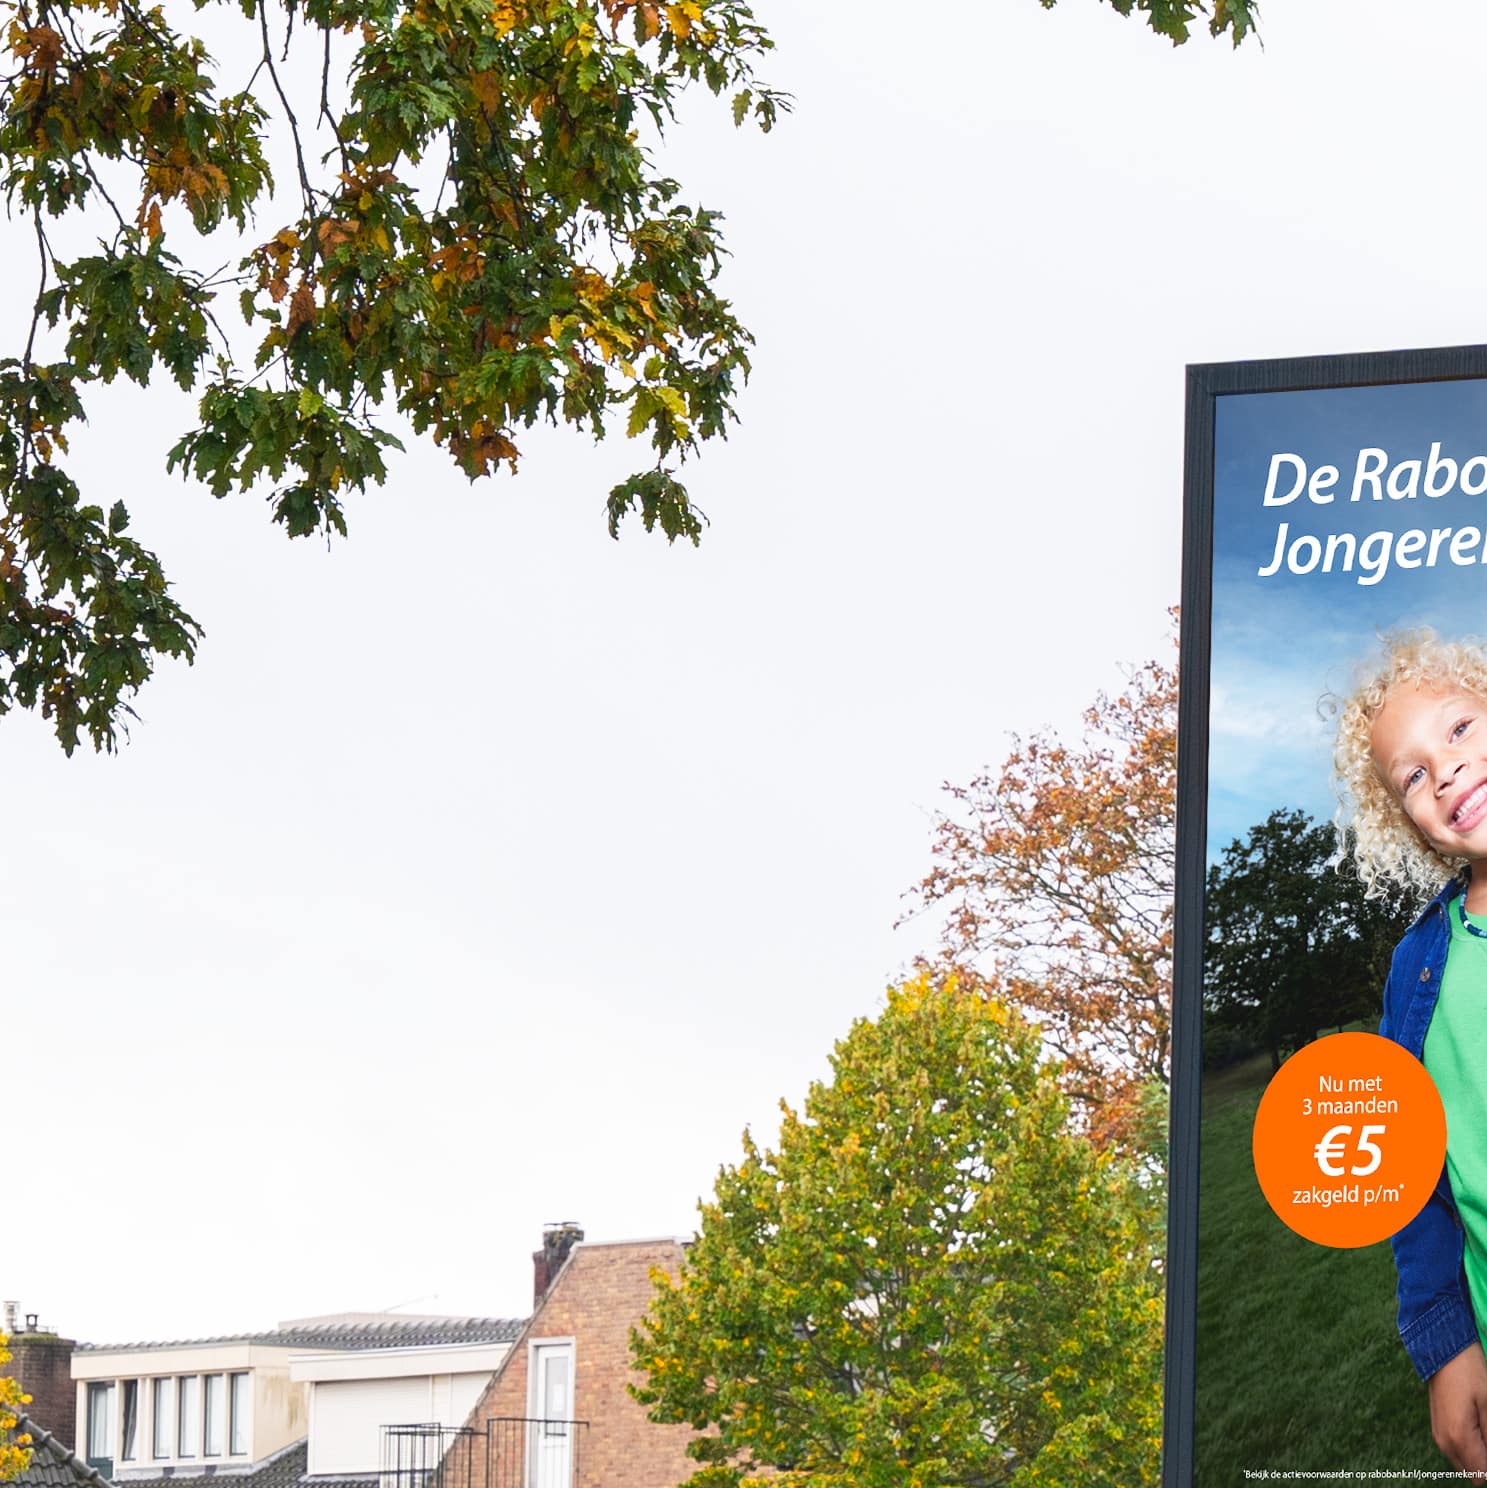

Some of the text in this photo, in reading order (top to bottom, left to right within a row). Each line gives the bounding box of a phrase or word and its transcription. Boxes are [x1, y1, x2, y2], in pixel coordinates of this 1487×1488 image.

[1263, 453, 1339, 507] De
[1318, 1076, 1382, 1093] Nu met
[1302, 1096, 1398, 1115] 3 maanden
[1313, 1125, 1386, 1177] €5
[1292, 1184, 1359, 1208] zakgeld
[1270, 1470, 1281, 1479] de
[1282, 1470, 1354, 1479] actievoorwaarden
[1355, 1471, 1367, 1481] op
